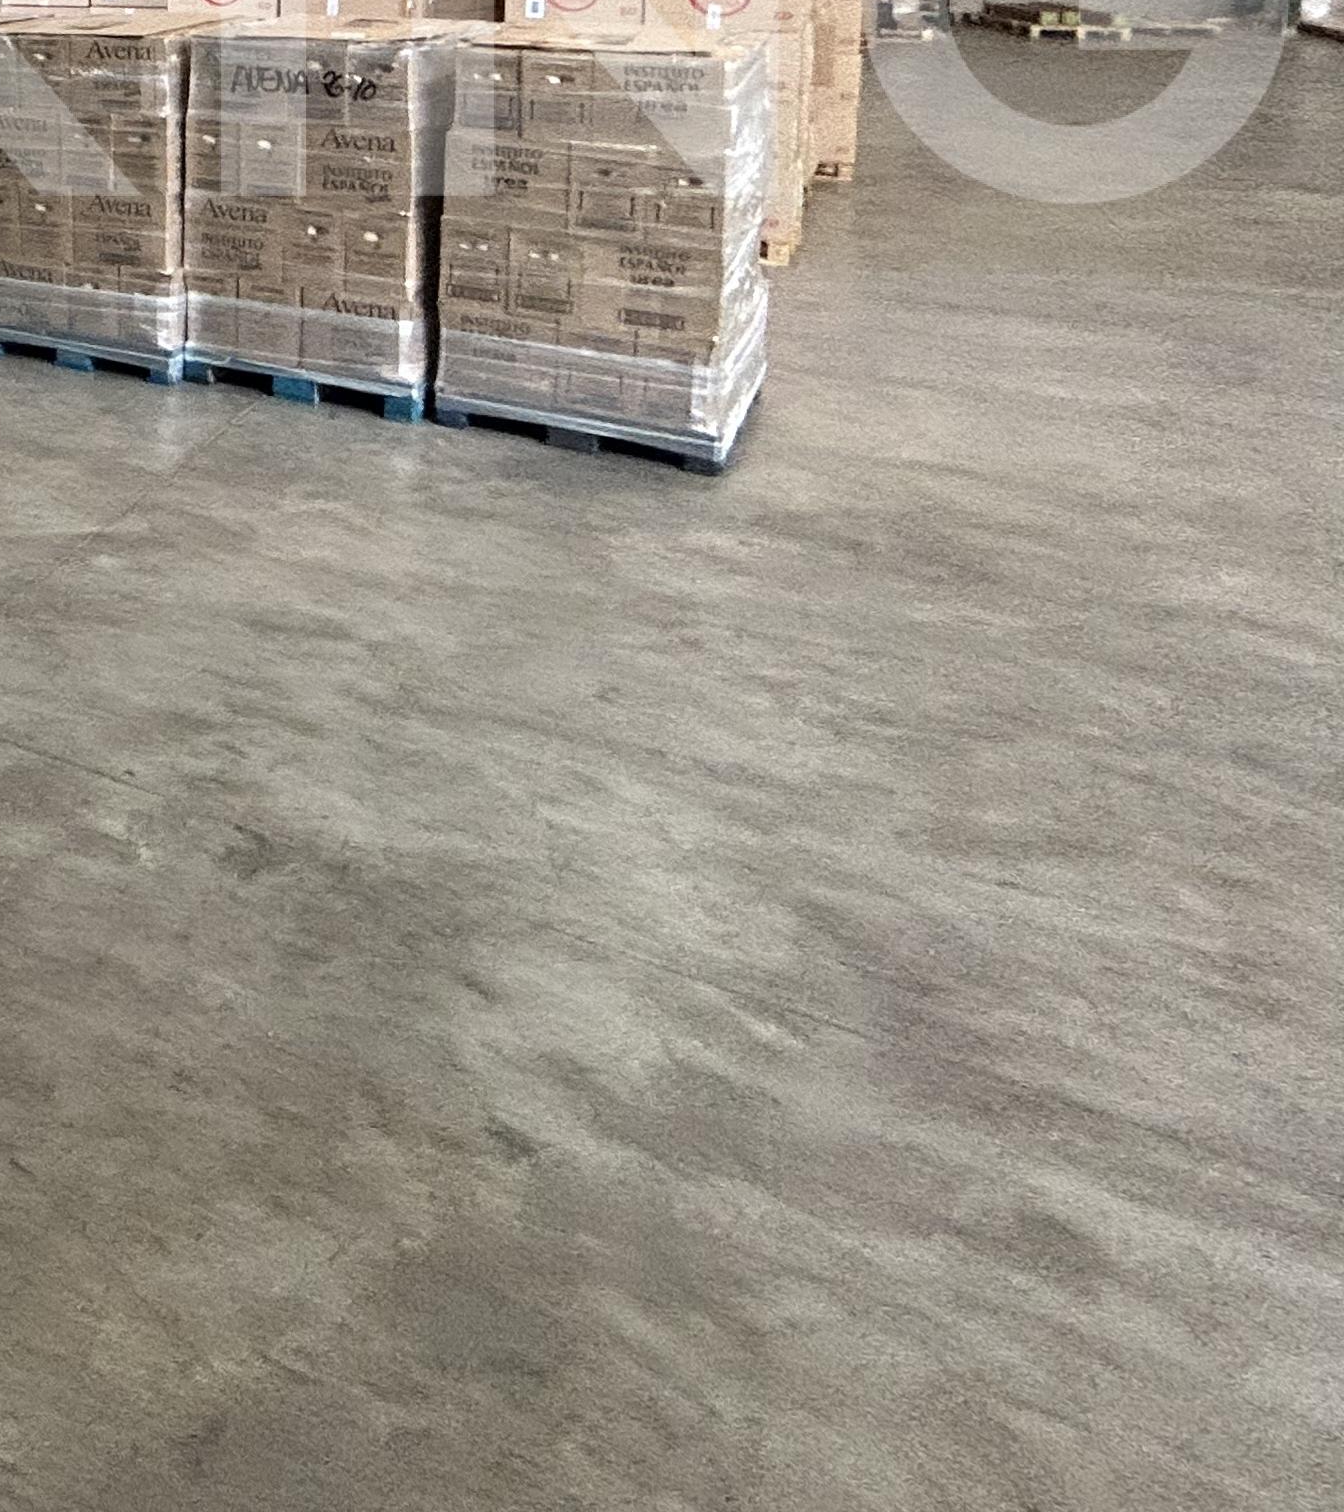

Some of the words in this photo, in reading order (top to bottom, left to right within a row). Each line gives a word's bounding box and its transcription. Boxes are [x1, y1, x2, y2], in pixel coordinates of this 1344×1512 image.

[86, 40, 152, 61] Avena
[231, 64, 310, 95] AVENA
[320, 128, 396, 153] Avena
[89, 195, 152, 218] Avena
[201, 198, 268, 224] Avena
[323, 293, 396, 321] Avena
